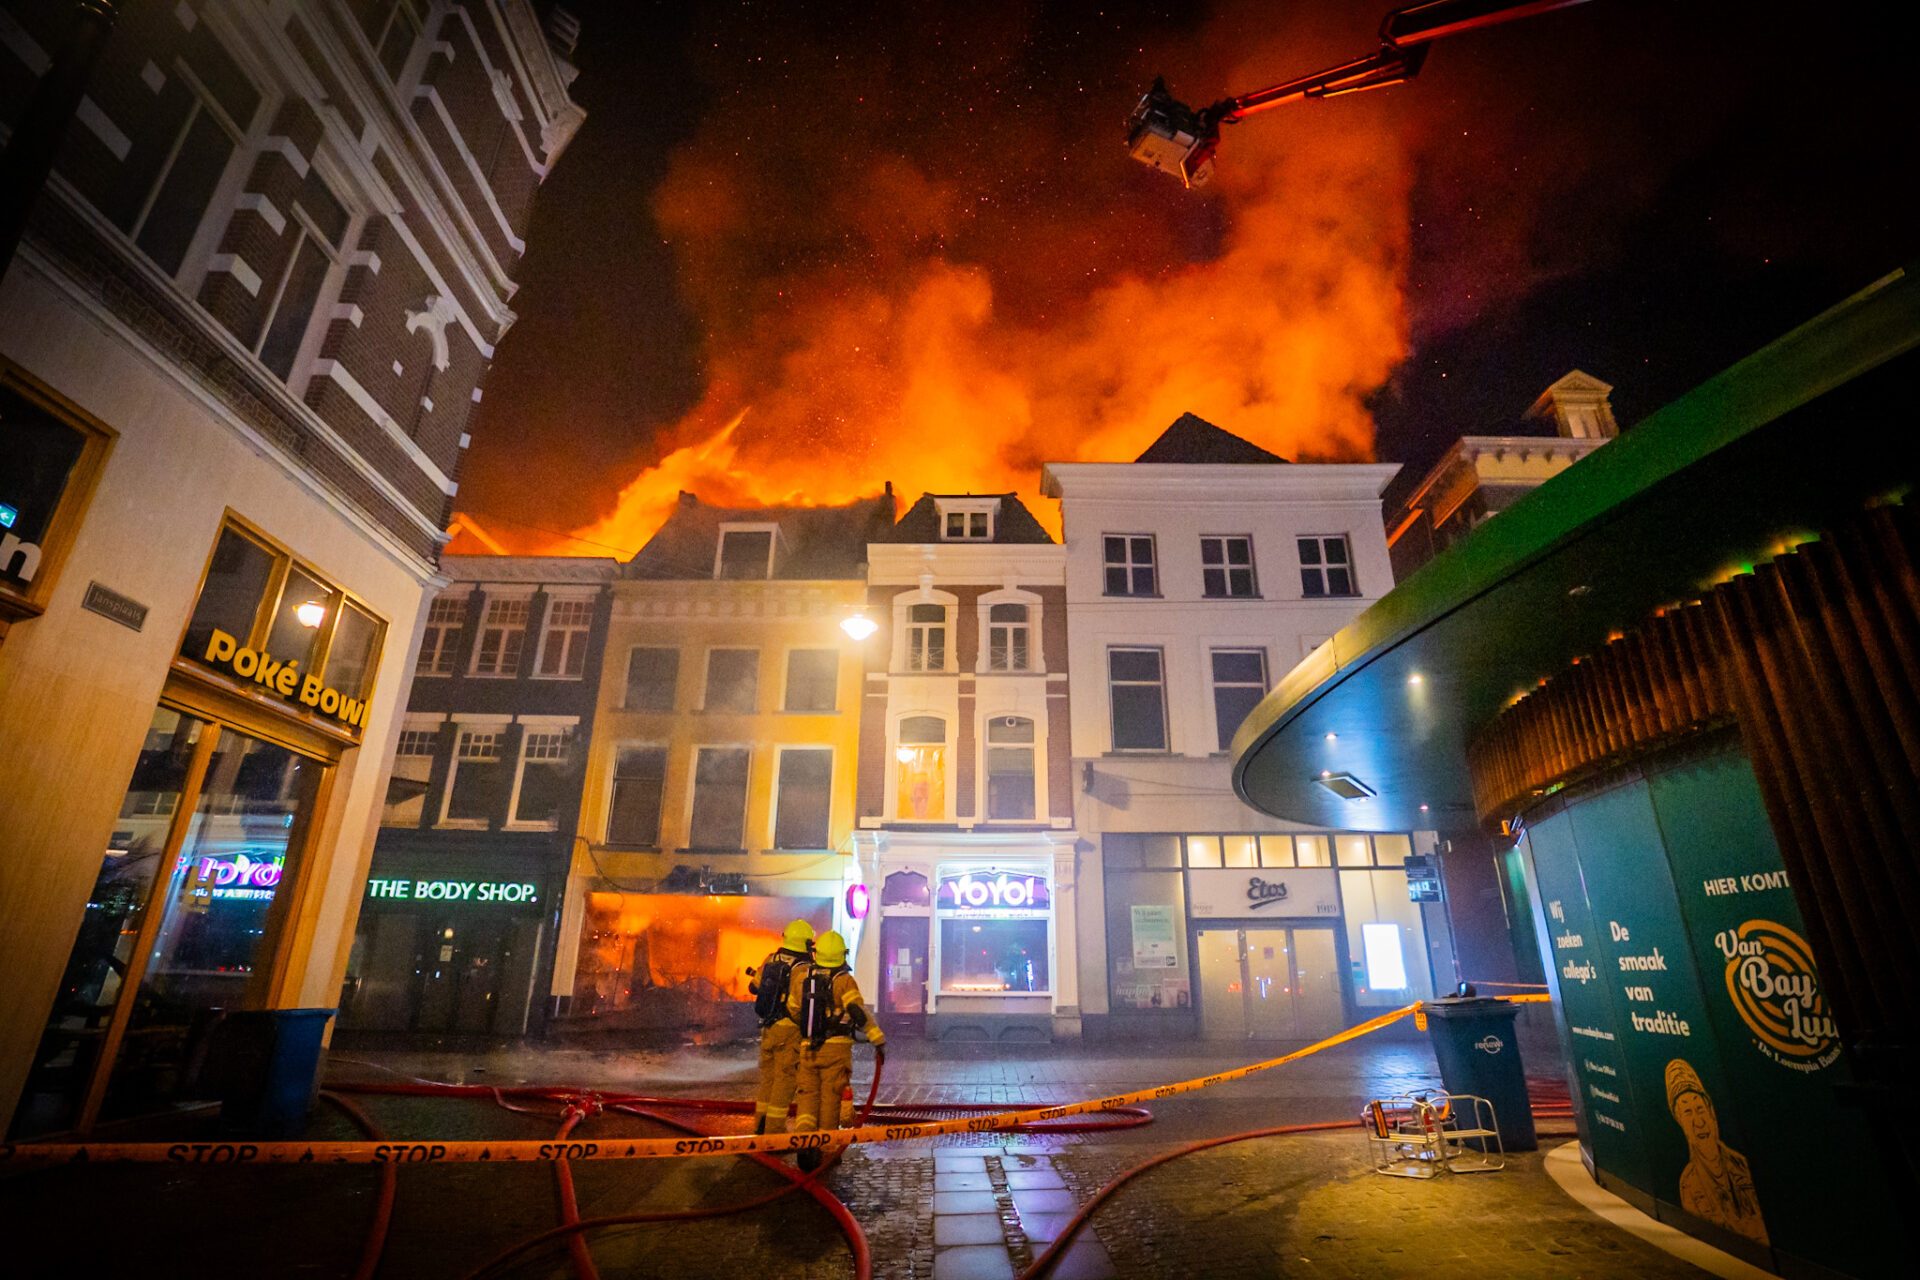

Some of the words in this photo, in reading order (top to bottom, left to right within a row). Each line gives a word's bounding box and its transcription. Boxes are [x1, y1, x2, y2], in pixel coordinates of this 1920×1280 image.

[368, 879, 410, 898] THE
[414, 881, 476, 900] BODY
[1246, 876, 1288, 902] Etos
[1704, 877, 1739, 897] HIER
[1740, 870, 1790, 893] KOMT
[1549, 900, 1565, 923] Wij
[1556, 929, 1583, 949] zoeken
[1610, 921, 1630, 942] De
[1714, 929, 1765, 960] Van
[1562, 959, 1598, 985] collega's
[1618, 947, 1667, 971] smaak
[1624, 986, 1654, 1002] van
[1739, 956, 1817, 1009] Bay
[1631, 1011, 1691, 1037] traditie
[372, 1144, 446, 1162] STOP
[538, 1143, 598, 1160] STOP
[675, 1139, 725, 1155] STOP
[789, 1133, 831, 1150] STOP
[885, 1126, 922, 1141] STOP
[968, 1117, 1000, 1131] STOP
[1040, 1107, 1067, 1120] STOP
